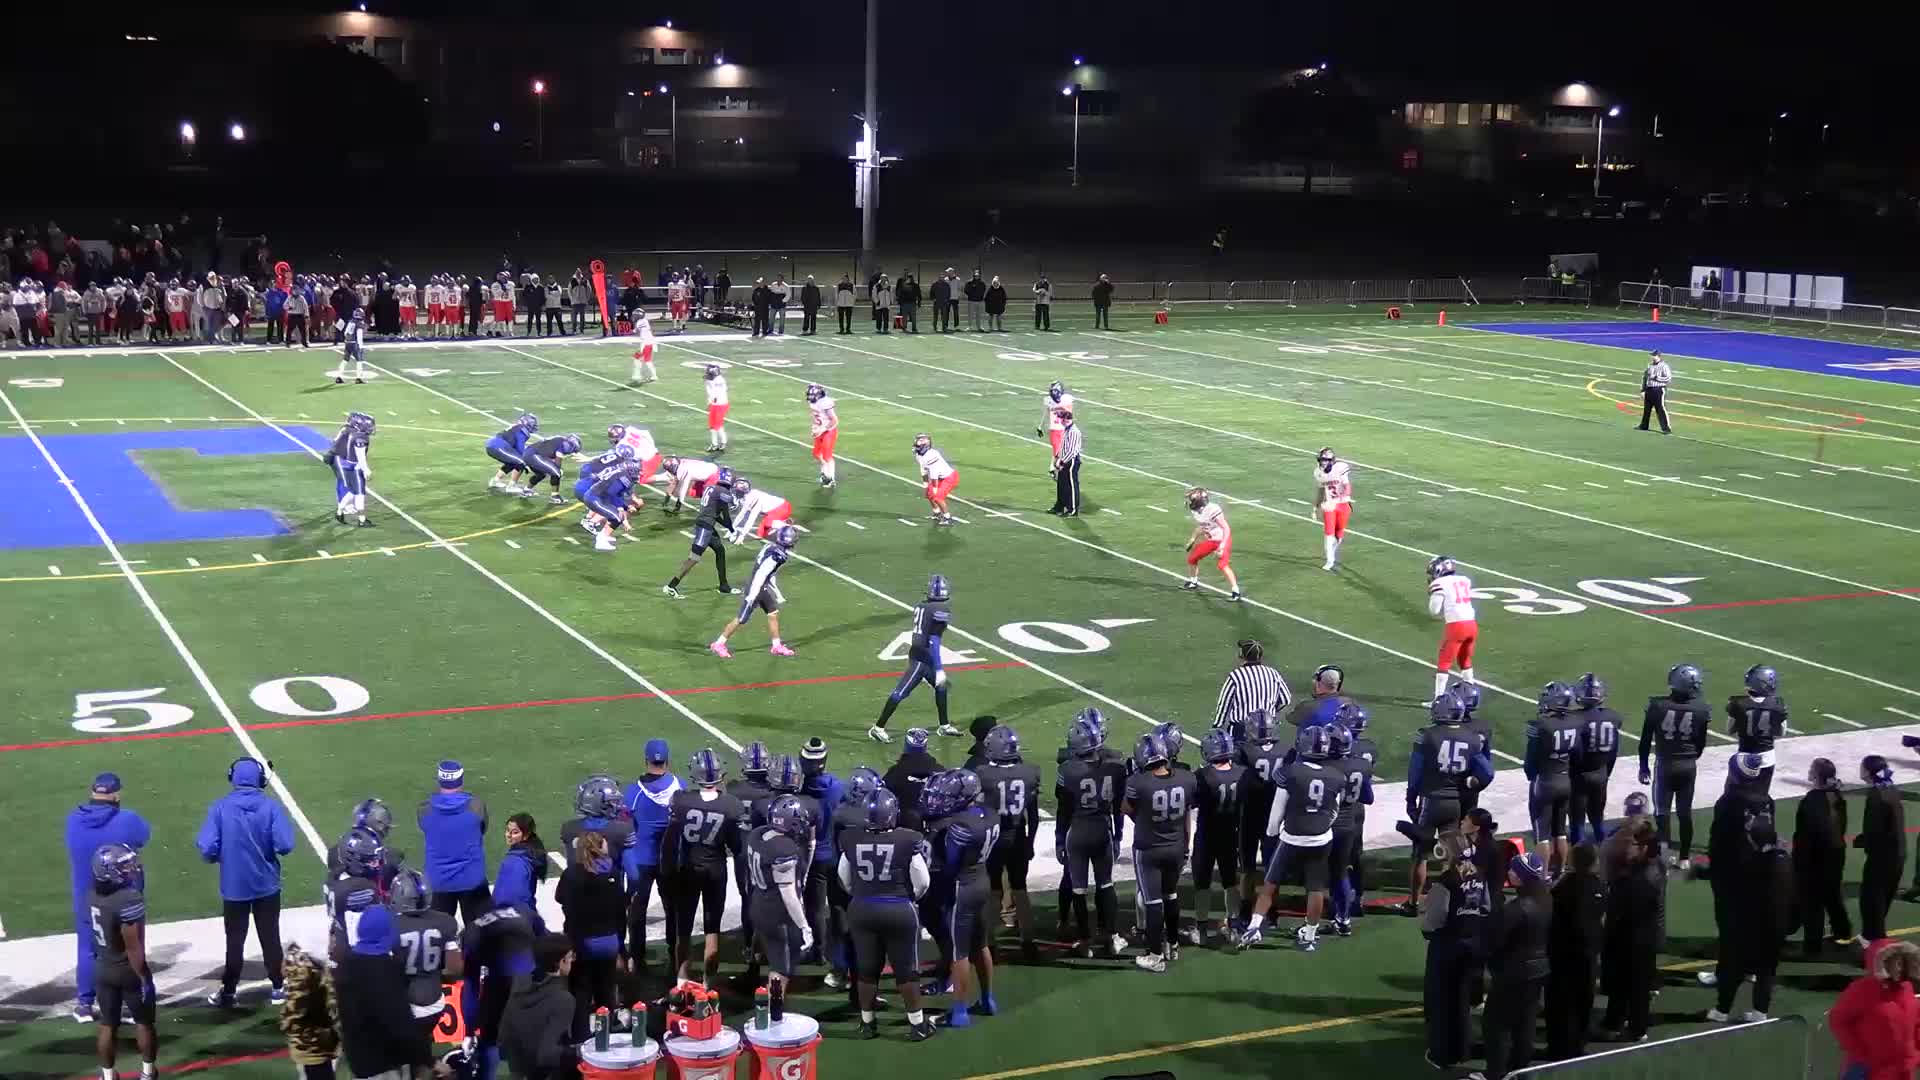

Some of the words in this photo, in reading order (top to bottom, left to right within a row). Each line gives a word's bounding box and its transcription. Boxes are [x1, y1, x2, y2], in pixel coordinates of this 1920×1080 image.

[912, 607, 925, 634] 21
[72, 676, 370, 732] 50
[1589, 721, 1614, 752] 10
[1661, 710, 1693, 740] 44
[1745, 709, 1772, 736] 14
[1437, 740, 1469, 774] 45
[1553, 729, 1577, 760] 17
[996, 779, 1026, 815] 13
[1079, 775, 1113, 809] 24
[1151, 786, 1186, 823] 99
[1218, 782, 1239, 814] 11
[1307, 779, 1325, 813] 9
[683, 808, 725, 845] 27
[855, 843, 894, 882] 57
[90, 905, 107, 949] 5
[400, 928, 443, 975] 76
[679, 1020, 688, 1033] G
